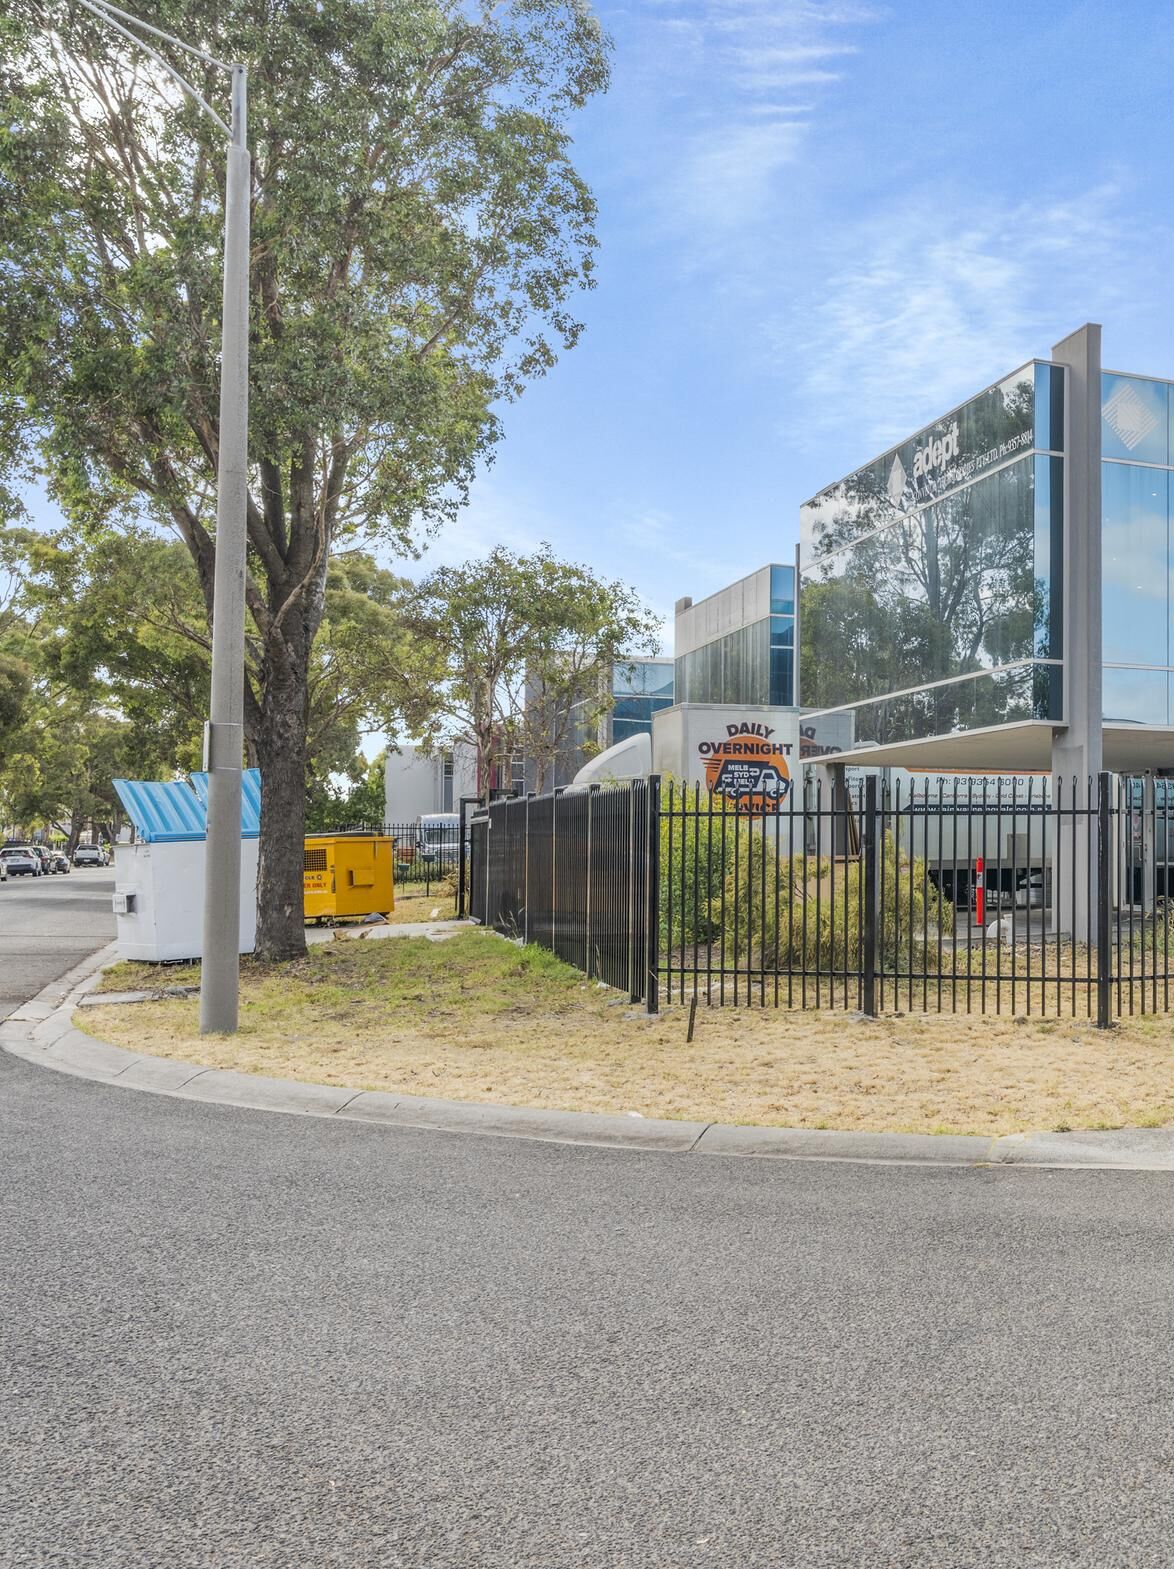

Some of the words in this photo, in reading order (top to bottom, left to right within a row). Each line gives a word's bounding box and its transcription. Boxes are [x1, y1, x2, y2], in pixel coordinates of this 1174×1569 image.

[913, 421, 960, 478] adept
[726, 722, 775, 739] DAILY
[698, 742, 793, 755] OVERNIGHT
[1000, 778, 1024, 786] 600
